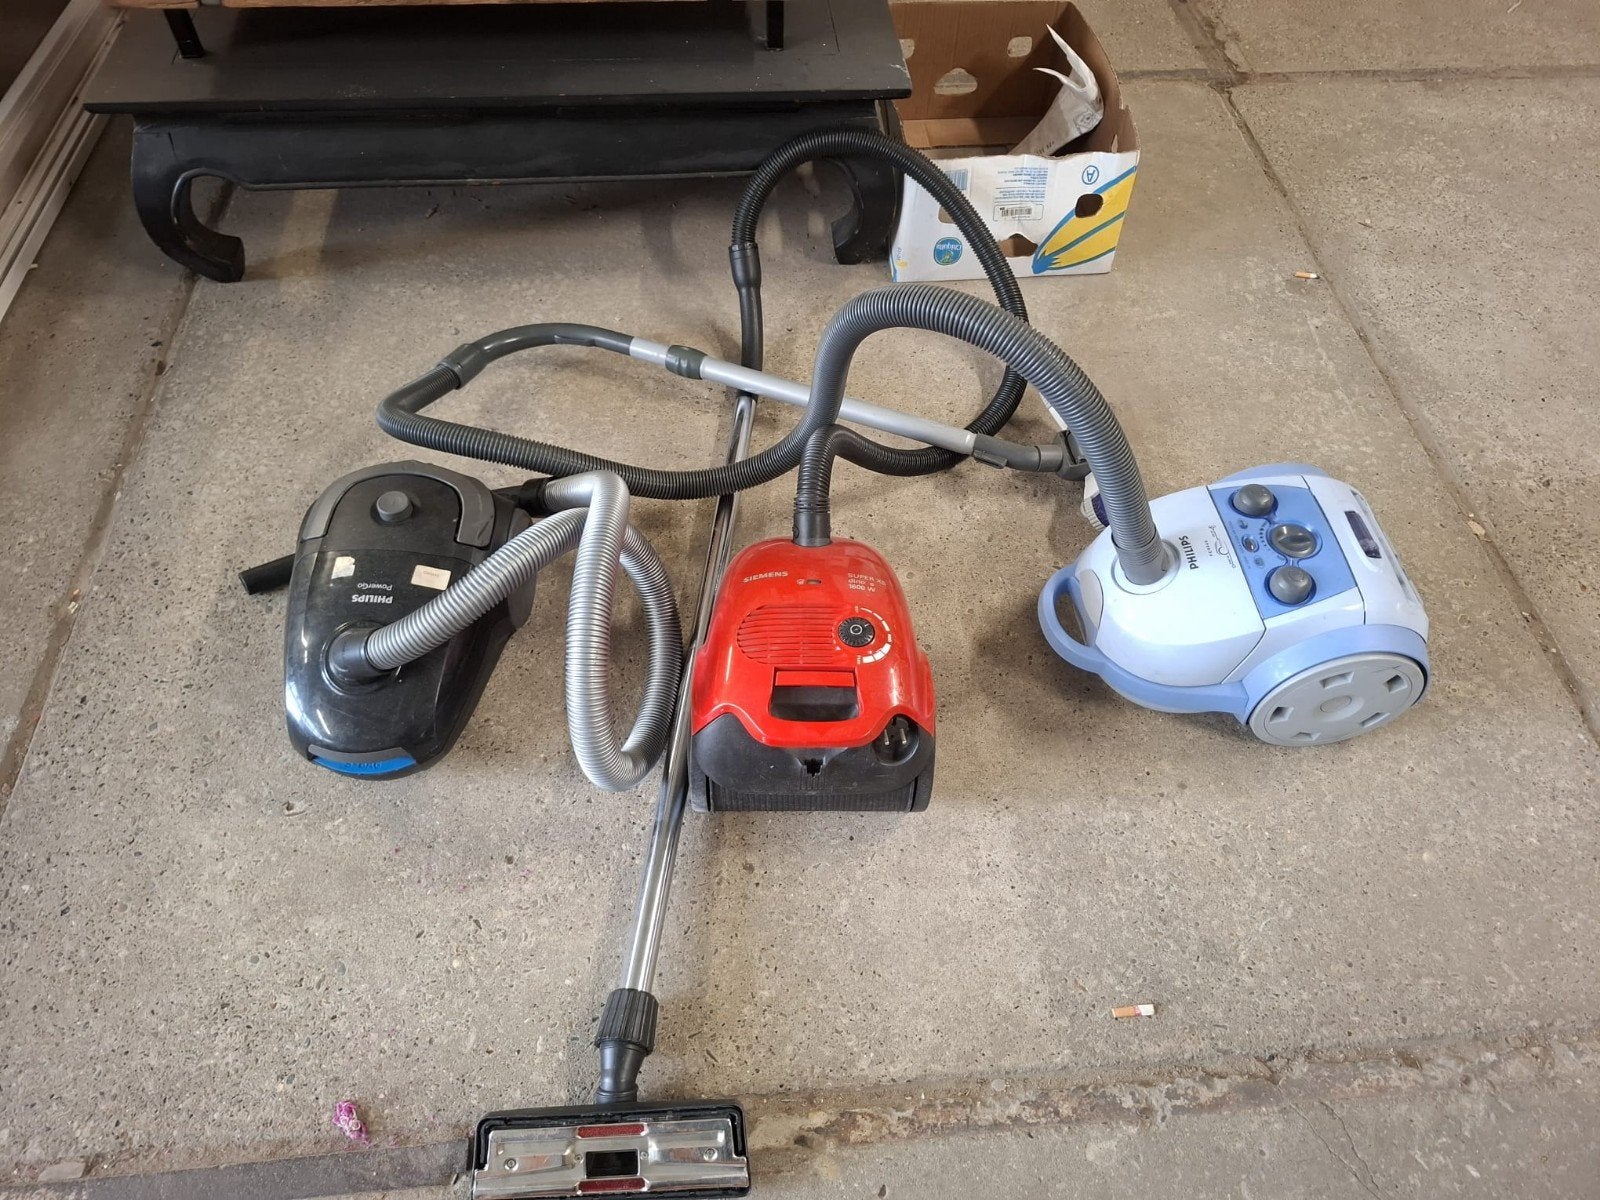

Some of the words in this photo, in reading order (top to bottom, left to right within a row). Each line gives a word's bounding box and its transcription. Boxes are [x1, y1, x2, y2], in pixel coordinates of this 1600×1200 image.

[1086, 169, 1095, 182] A
[1178, 535, 1199, 570] PHILIPS
[742, 570, 789, 583] SIEMENS
[848, 572, 875, 582] SUPER
[357, 582, 393, 591] PowerGo
[849, 583, 866, 591] 1600
[351, 594, 393, 604] PHILIPS
